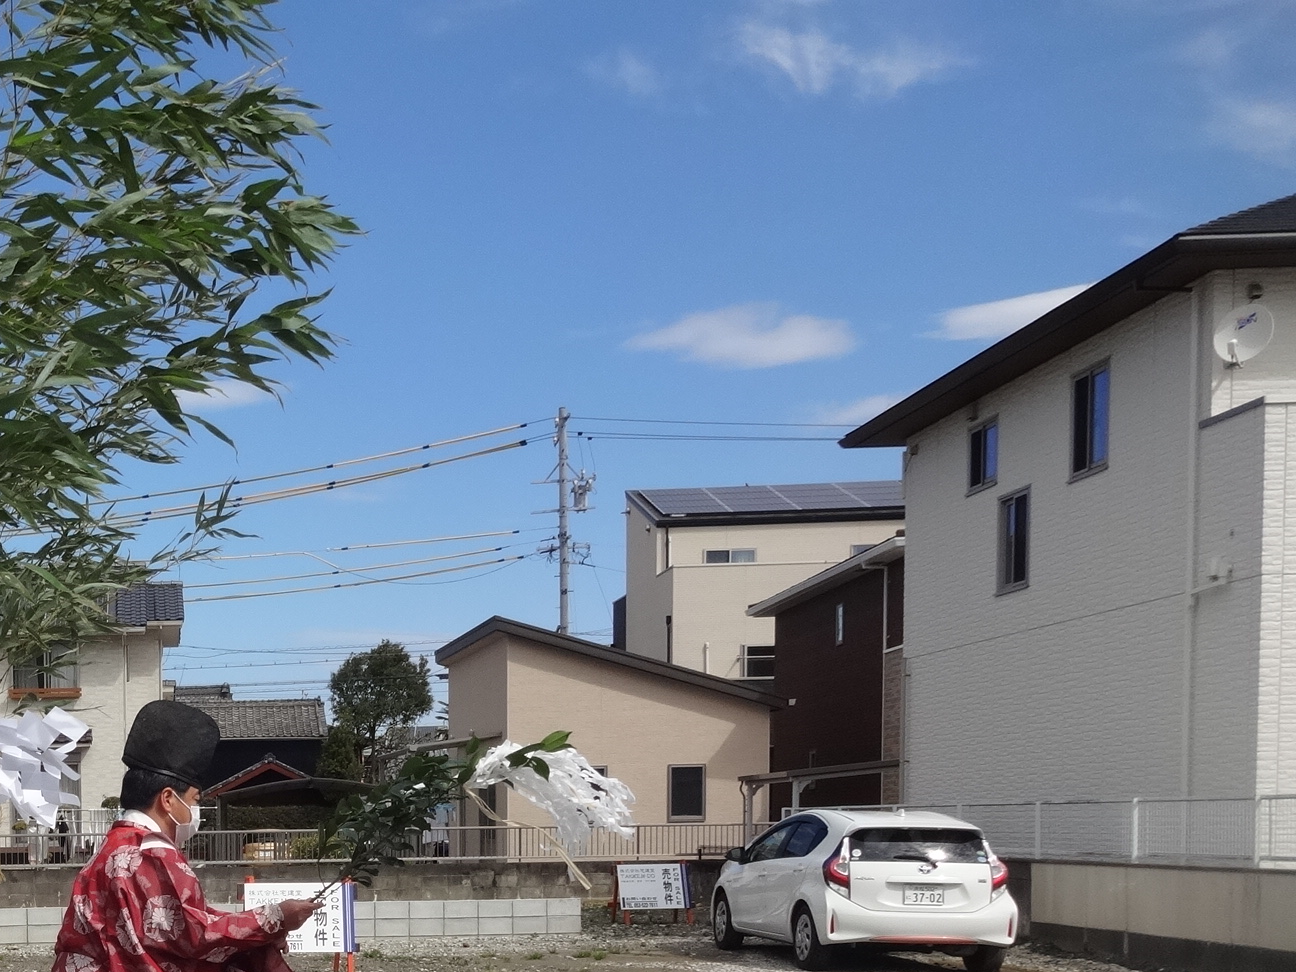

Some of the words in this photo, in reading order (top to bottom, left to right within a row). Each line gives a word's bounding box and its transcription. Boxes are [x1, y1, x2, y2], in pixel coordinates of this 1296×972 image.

[672, 868, 680, 881] FOR
[661, 868, 674, 905] 売物件
[330, 890, 340, 910] FOR
[912, 892, 942, 903] 37-02
[332, 918, 340, 947] SALE
